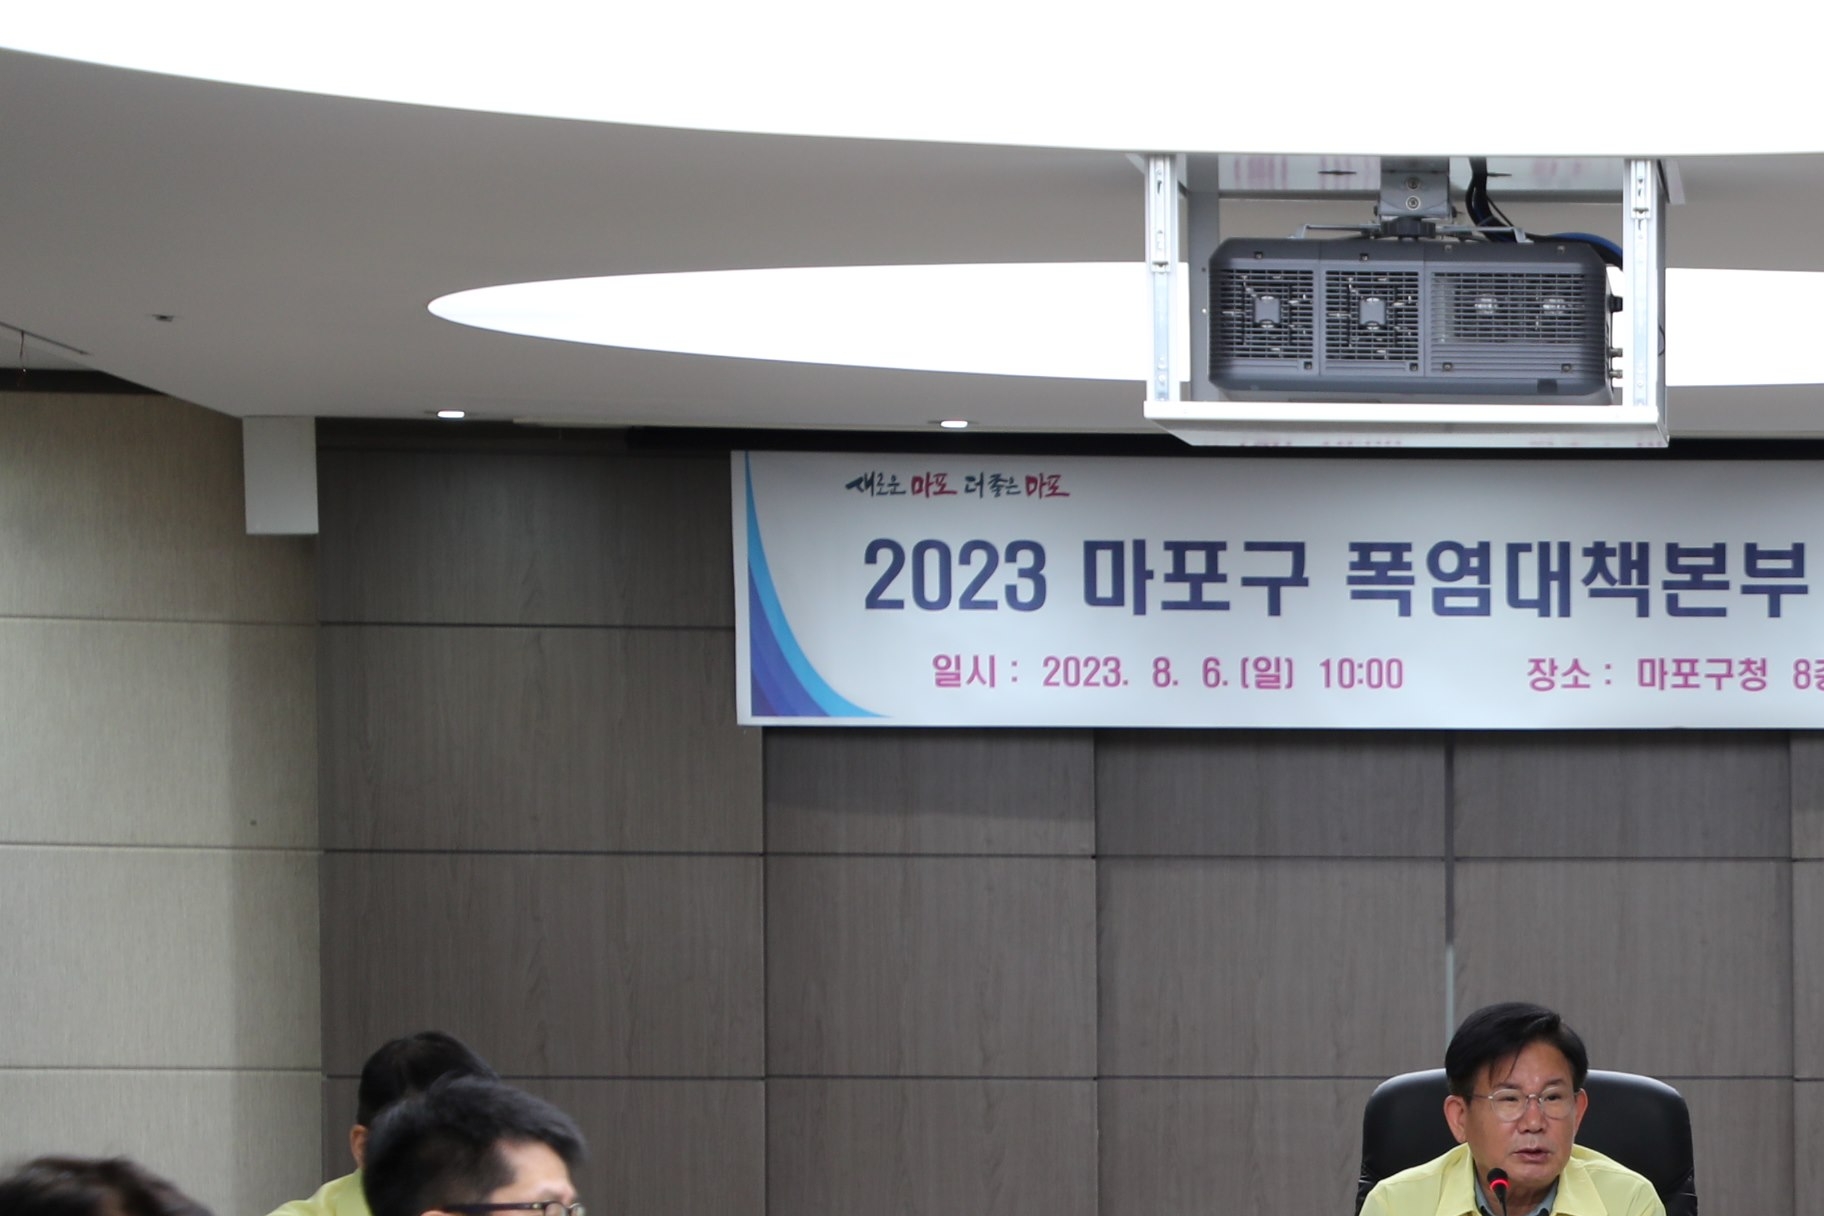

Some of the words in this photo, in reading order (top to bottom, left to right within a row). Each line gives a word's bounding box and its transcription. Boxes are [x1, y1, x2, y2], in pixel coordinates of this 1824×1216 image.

[845, 471, 906, 498] 새로운
[911, 471, 958, 498] 마포
[964, 472, 984, 498] 더
[988, 472, 1021, 498] 좋은
[1025, 472, 1071, 499] 마포
[864, 538, 1047, 613] 2023
[1083, 538, 1310, 617] 마포구
[1346, 540, 1809, 618] 폭염대책본부
[932, 653, 996, 689] 일시
[1042, 655, 1129, 689] 2023.
[1152, 655, 1179, 689] 8.
[1319, 657, 1404, 690] 10:00
[1526, 657, 1591, 692] 장소
[1637, 657, 1767, 692] 마포구청
